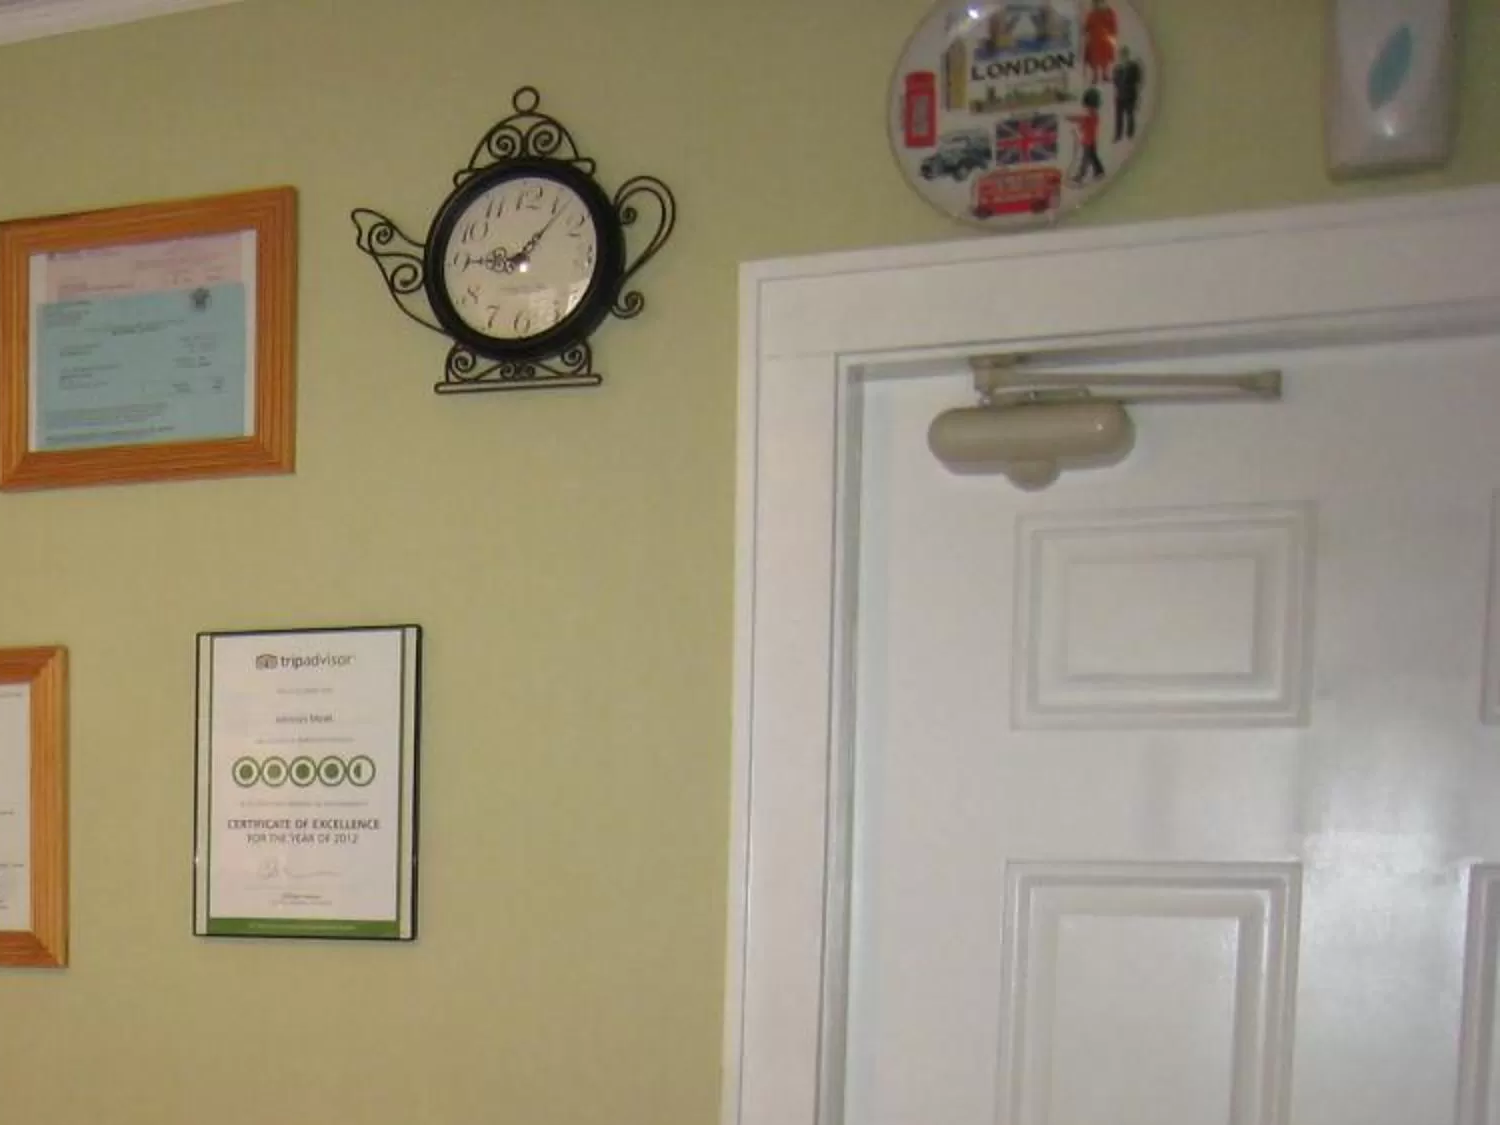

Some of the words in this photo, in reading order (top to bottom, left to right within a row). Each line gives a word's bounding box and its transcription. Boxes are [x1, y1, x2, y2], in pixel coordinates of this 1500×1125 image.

[971, 51, 1075, 81] LONDON
[280, 653, 352, 669] tripadvisor
[227, 818, 291, 830] CERTIFICATE
[295, 818, 309, 829] OF
[312, 818, 381, 830] EXCELLENCE
[247, 834, 267, 844] FOR
[269, 834, 287, 844] THE
[290, 834, 314, 844] YEAR
[317, 833, 330, 844] OF
[333, 833, 359, 844] 2012
